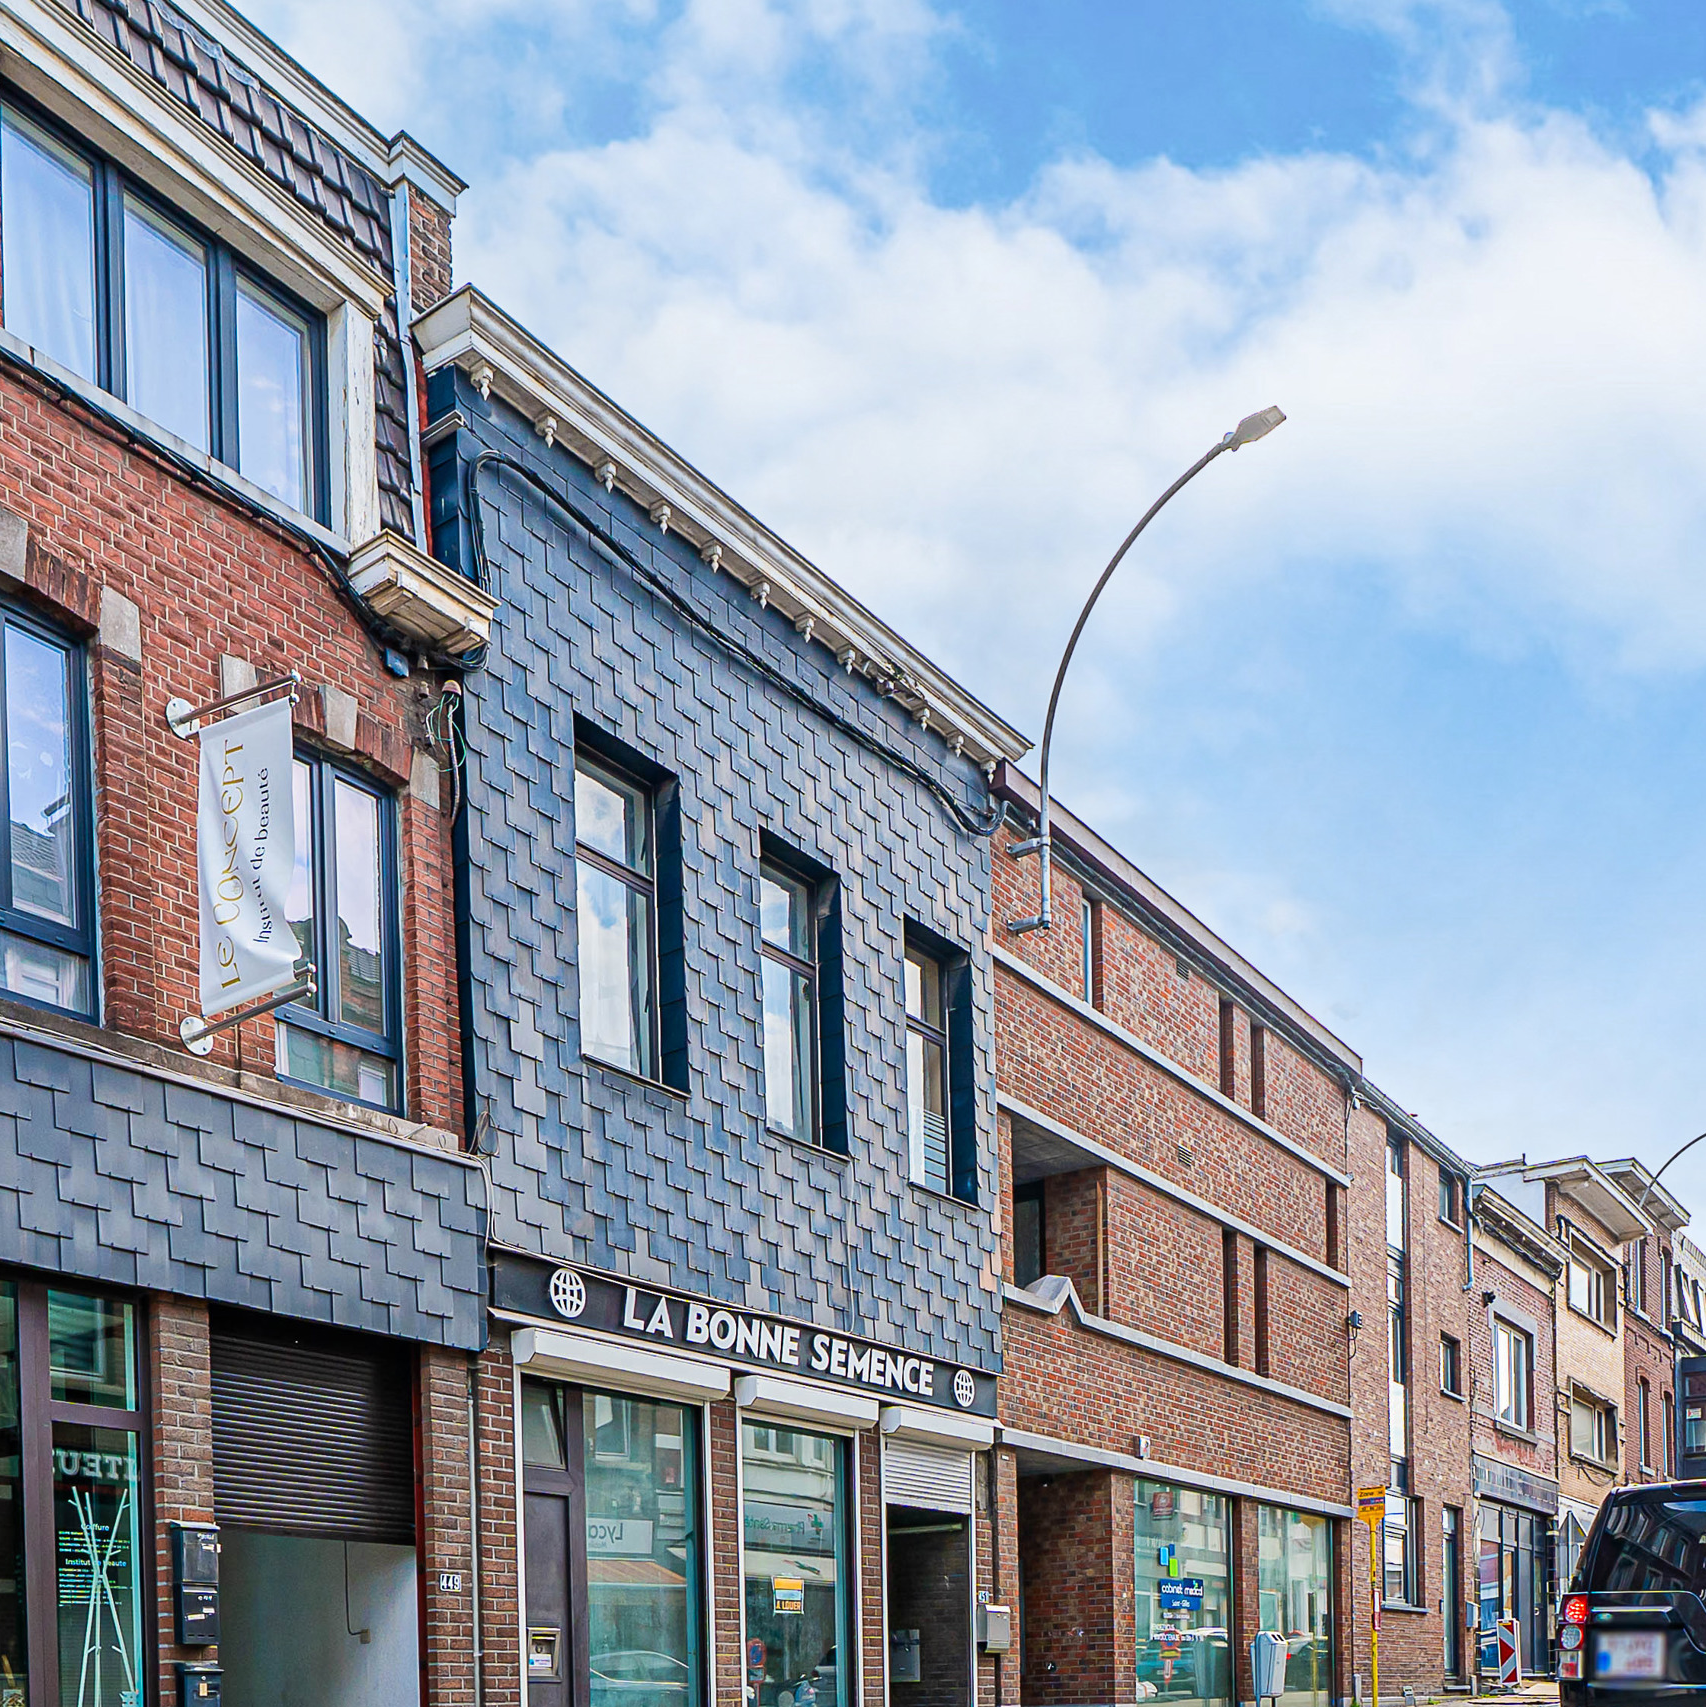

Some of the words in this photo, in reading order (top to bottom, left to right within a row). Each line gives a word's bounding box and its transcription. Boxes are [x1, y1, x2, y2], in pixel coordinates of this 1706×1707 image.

[213, 739, 244, 926] CONCEPT
[254, 767, 269, 842] beauté
[250, 847, 266, 871] de
[217, 935, 241, 989] LE
[623, 1287, 674, 1339] LA
[686, 1302, 801, 1367] BONNE
[811, 1332, 935, 1397] SEMENCE
[441, 1575, 460, 1590] 449
